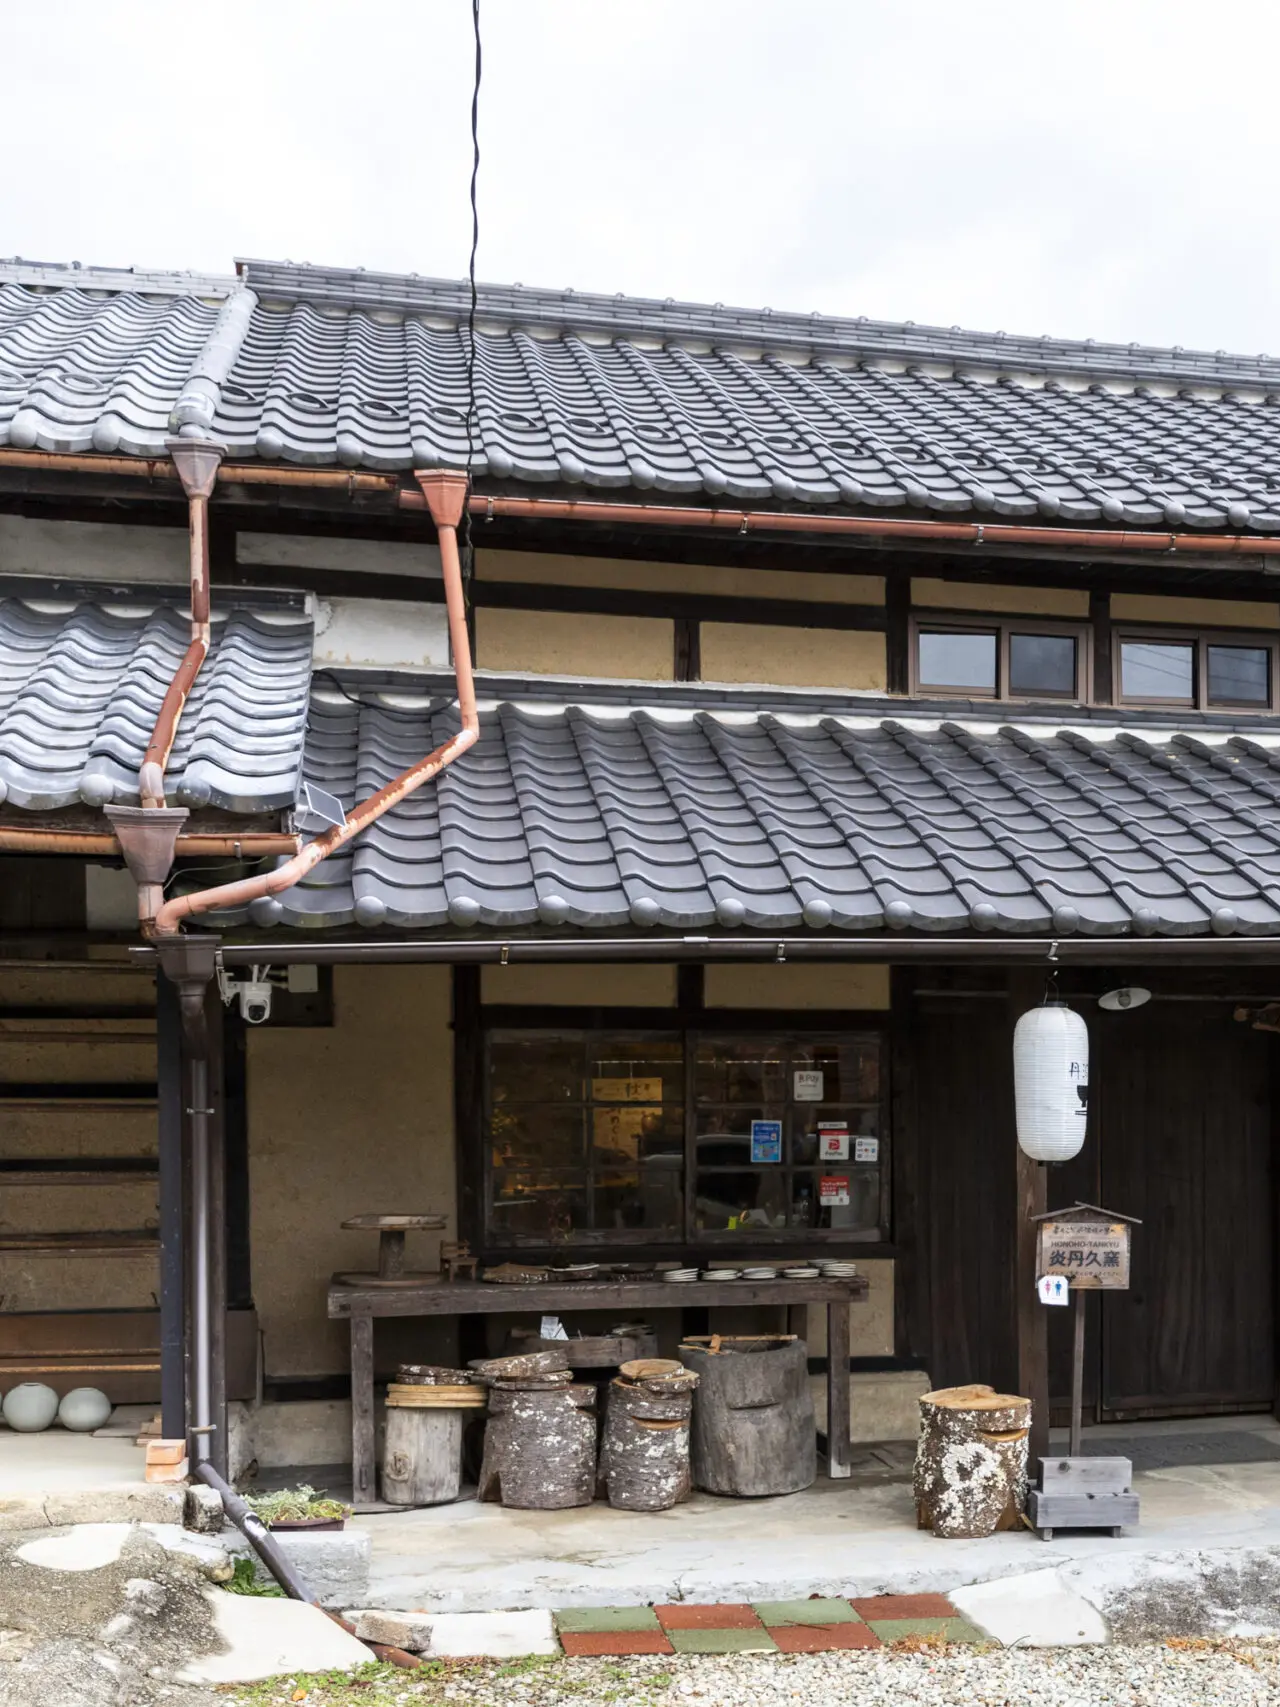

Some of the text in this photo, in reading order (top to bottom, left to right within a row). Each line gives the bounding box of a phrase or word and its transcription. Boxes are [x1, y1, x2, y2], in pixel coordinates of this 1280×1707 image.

[1051, 1240, 1120, 1249] HONOHO-TANKYU
[1048, 1249, 1121, 1268] 炎丹久窯
